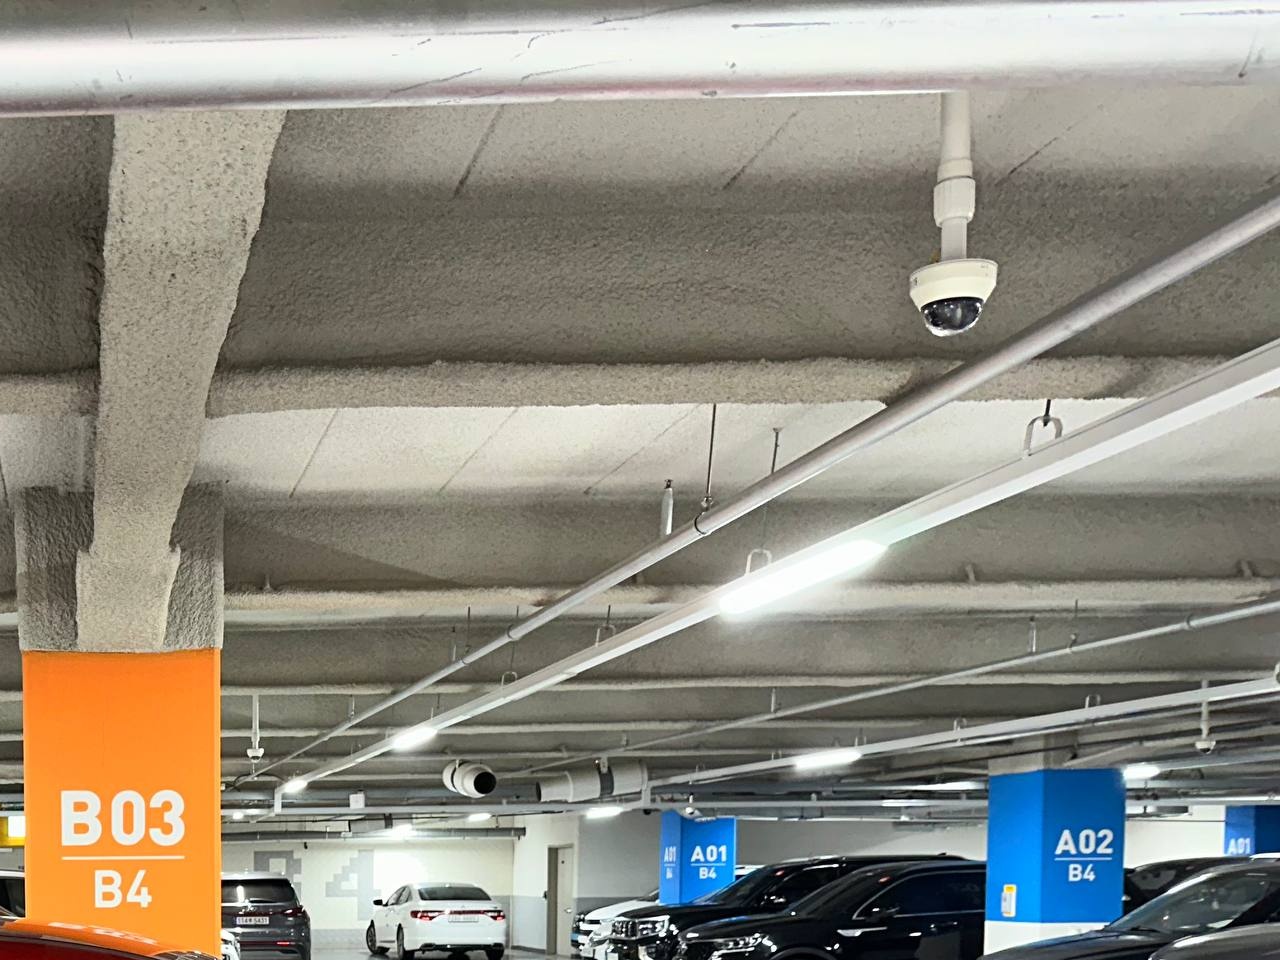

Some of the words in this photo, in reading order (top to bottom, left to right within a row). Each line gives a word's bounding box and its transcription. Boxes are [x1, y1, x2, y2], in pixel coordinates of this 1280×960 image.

[60, 789, 185, 846] B03
[1054, 829, 1114, 855] A02
[690, 845, 727, 863] A01
[699, 867, 717, 879] B4
[1068, 864, 1096, 882] B4
[94, 869, 153, 909] B4
